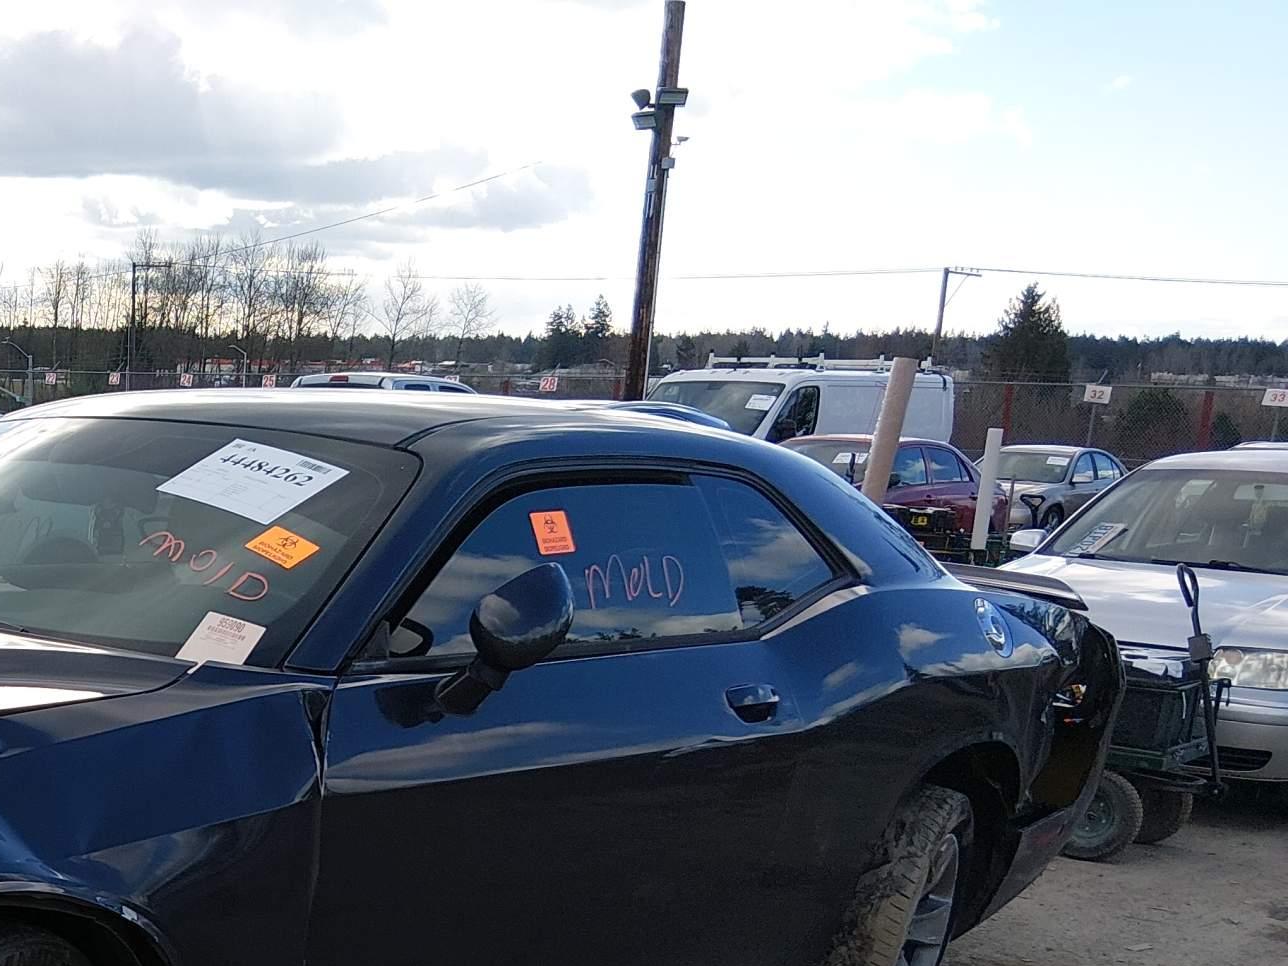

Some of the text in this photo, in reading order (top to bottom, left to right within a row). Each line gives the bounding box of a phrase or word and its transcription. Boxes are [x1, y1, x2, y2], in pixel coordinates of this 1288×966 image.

[46, 373, 56, 384] 22
[110, 373, 120, 384] 23
[181, 374, 192, 386] 24
[262, 375, 275, 388] 25
[541, 377, 556, 391] 28
[1090, 389, 1105, 400] 32
[1270, 392, 1286, 402] 33
[219, 452, 314, 488] 44484262
